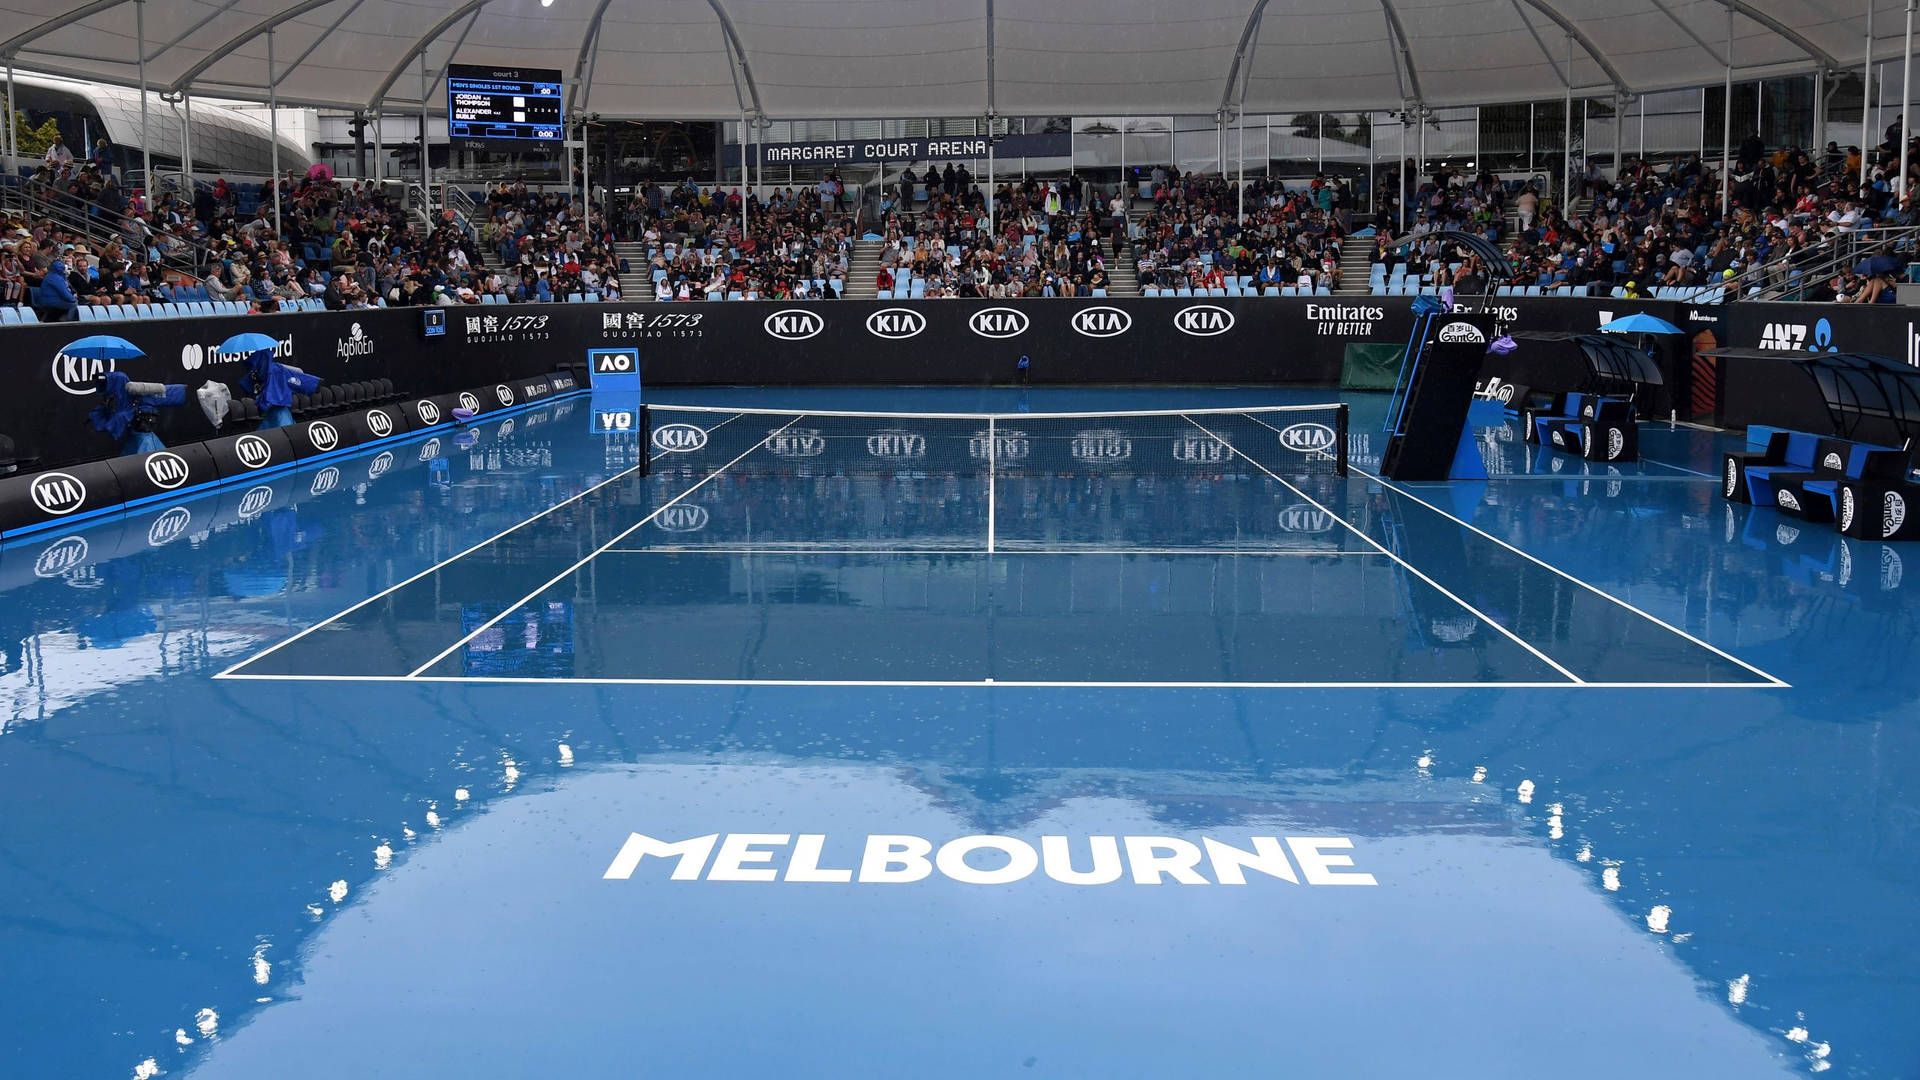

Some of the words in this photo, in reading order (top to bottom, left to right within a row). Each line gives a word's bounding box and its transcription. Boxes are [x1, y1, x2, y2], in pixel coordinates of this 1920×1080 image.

[767, 145, 855, 160] MARGARET
[864, 143, 918, 158] COURT
[928, 140, 986, 155] ARENA
[1306, 303, 1384, 320] Emirates
[775, 316, 814, 333] KIA
[876, 315, 916, 332] KIA
[979, 314, 1019, 332] KIA
[1082, 314, 1121, 331] KIA
[1184, 312, 1224, 329] KIA
[1318, 322, 1334, 335] FLY
[1336, 322, 1372, 335] BETTER
[467, 334, 513, 344] GUOJIAO
[522, 332, 549, 340] 1573
[603, 330, 662, 338] GUOJIAO
[1759, 323, 1807, 350] ANZ
[337, 335, 374, 362] AgBioEn
[600, 355, 630, 371] AO
[662, 430, 699, 447] KIA
[1289, 429, 1326, 446] KIA
[240, 440, 268, 462] KIA
[150, 458, 184, 482] KIA
[37, 480, 80, 507] KIA
[603, 831, 1379, 886] MELBOURNE
